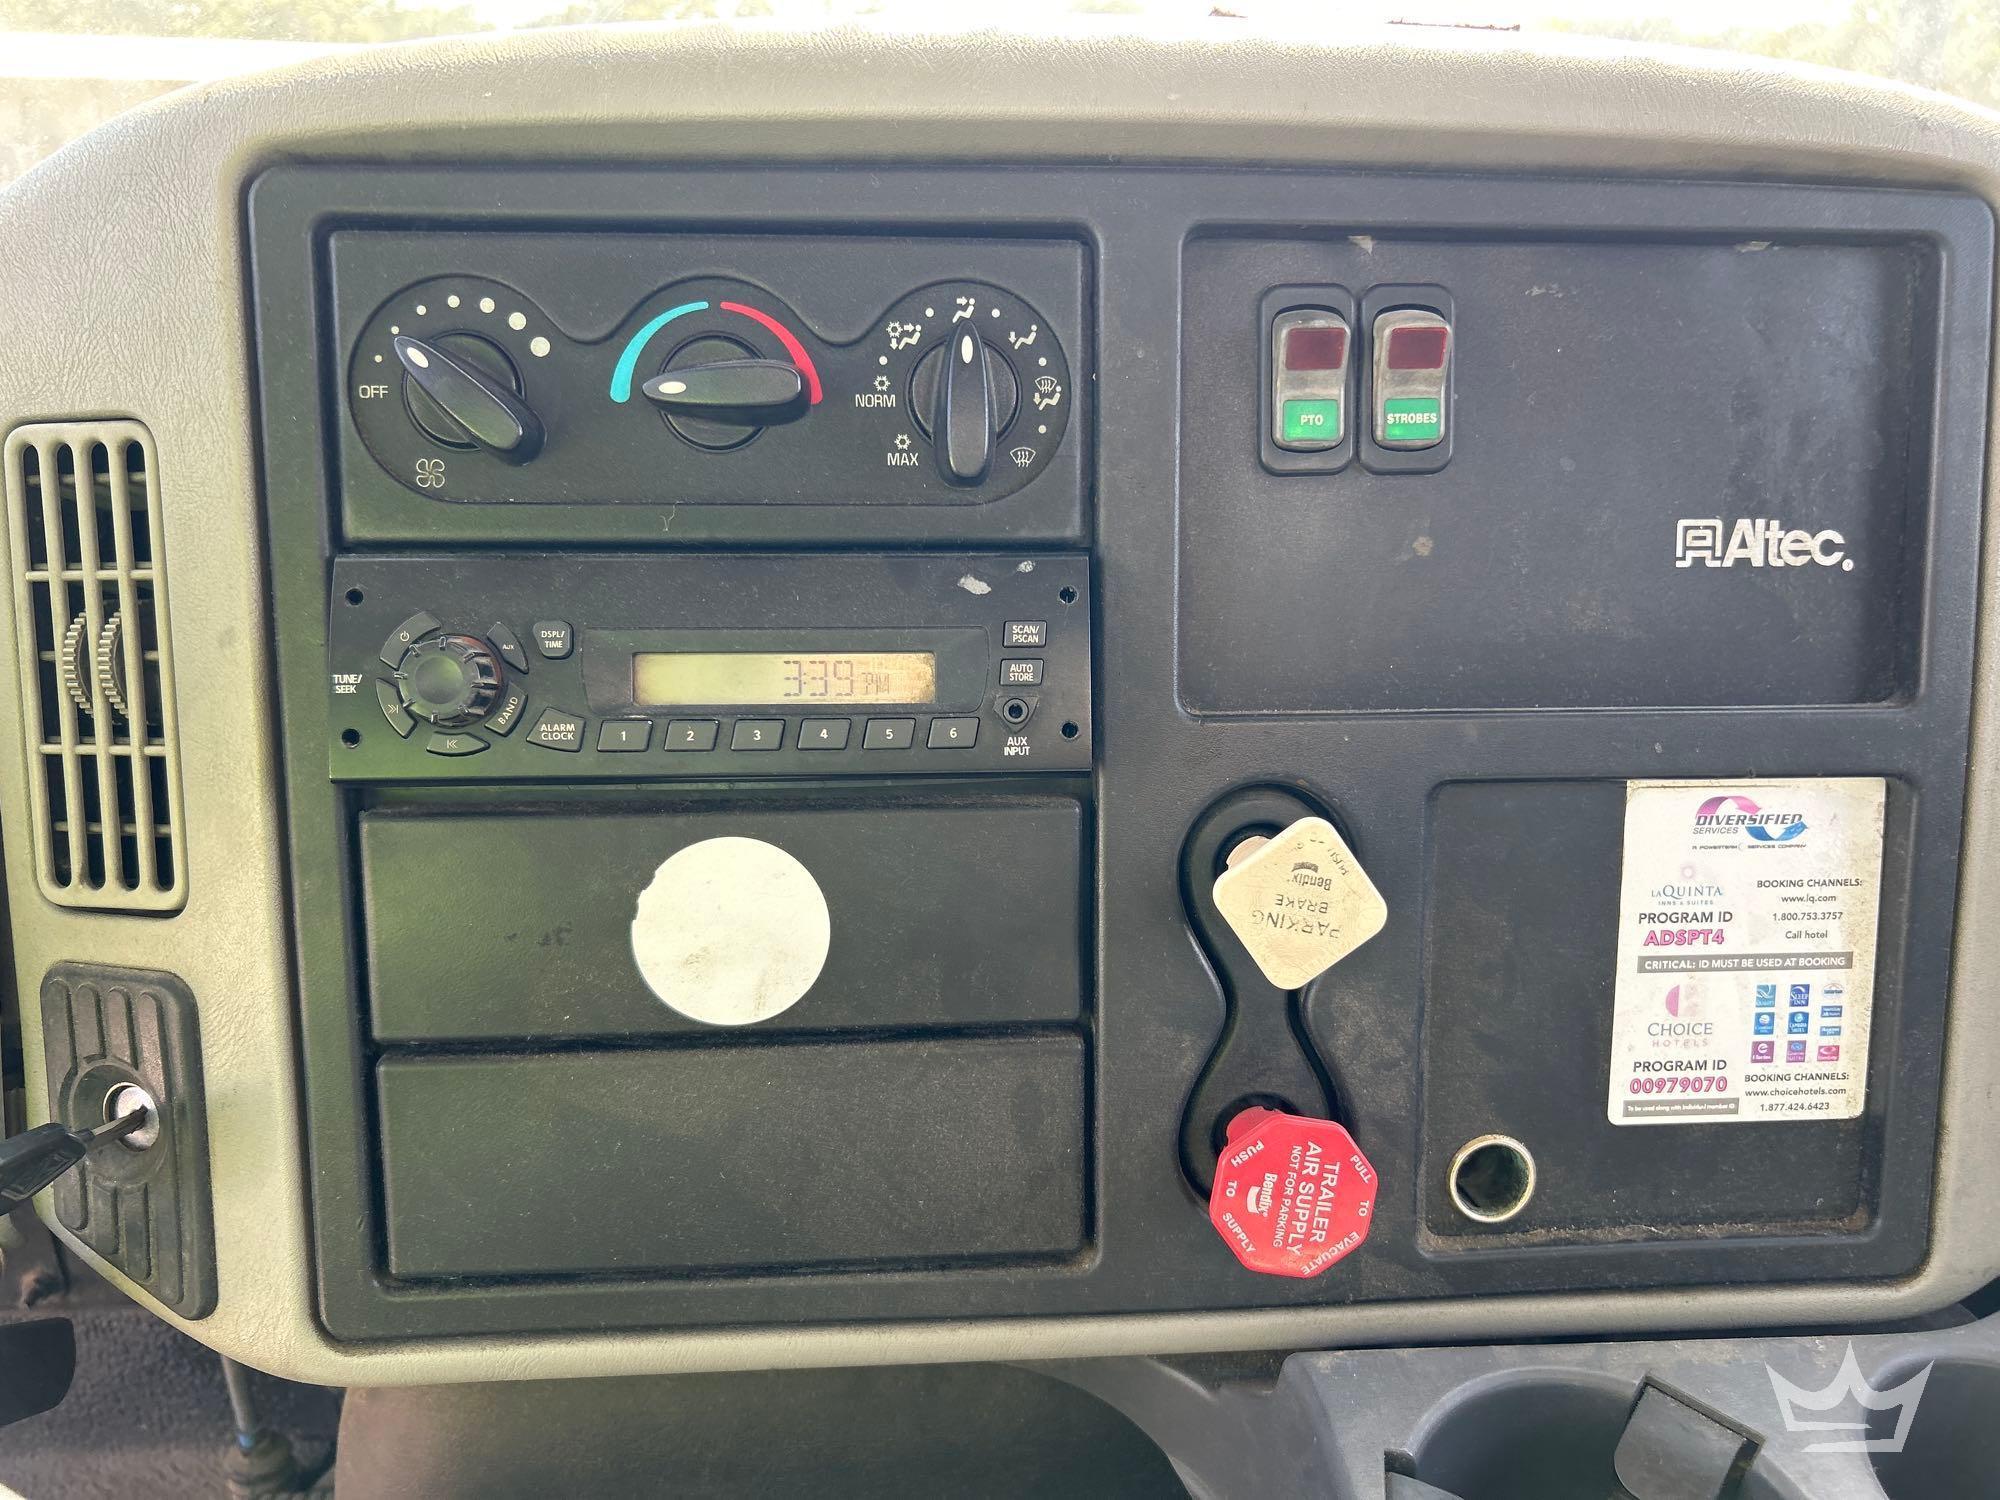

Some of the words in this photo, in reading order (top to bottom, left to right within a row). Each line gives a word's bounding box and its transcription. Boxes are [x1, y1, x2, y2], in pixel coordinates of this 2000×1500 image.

[358, 385, 389, 399] OFF
[855, 394, 896, 408] NORM
[1300, 414, 1323, 426] PTO
[1386, 413, 1438, 424] STROBES
[887, 452, 919, 466] MAX
[541, 630, 565, 640] DSPL/
[1012, 625, 1040, 635] SCAN/
[1012, 633, 1039, 643] PSCAN
[544, 640, 563, 649] TIME
[1009, 664, 1034, 674] AUTO
[333, 674, 362, 685] TUNE/
[783, 660, 853, 697] 3:39
[1009, 673, 1034, 682] STORE
[335, 684, 357, 694] SEEK
[497, 696, 519, 726] BAND
[540, 723, 575, 733] ALARM
[950, 728, 957, 739] 6
[541, 731, 574, 741] CLOCK
[620, 731, 626, 741] 1
[686, 731, 694, 741] 2
[753, 730, 761, 741] 3
[820, 729, 828, 739] 4
[885, 729, 893, 740] 5
[1006, 736, 1028, 746] AUX
[1004, 746, 1030, 756] INPUT
[1695, 813, 1803, 826] DIVERSIFIED
[1692, 827, 1739, 835] SERVICES
[1757, 879, 1804, 888] BOOKING
[1806, 878, 1862, 888] CHANNELS:
[1275, 894, 1329, 914] BRAKE
[1781, 894, 1837, 905] www.lq.com
[1638, 911, 1714, 924] PROGRAM
[1718, 911, 1733, 923] ID
[1772, 911, 1843, 922] 1.800.753.3757
[1252, 909, 1342, 940] PARKING
[1643, 929, 1725, 947] ADSPT4
[1785, 931, 1803, 939] Call
[1805, 930, 1828, 939] hotel
[1644, 960, 1696, 970] CRITICAL:
[1699, 960, 1709, 969] ID
[1711, 959, 1739, 968] MUST
[1741, 959, 1753, 968] BE
[1756, 958, 1782, 967] USED
[1783, 958, 1796, 967] AT
[1798, 957, 1845, 967] BOOKING
[1647, 1022, 1713, 1037] CHOICE
[1652, 1038, 1709, 1048] HOTELS
[1633, 1060, 1707, 1072] PROGRAM
[1712, 1060, 1727, 1071] ID
[1745, 1073, 1791, 1083] BOOKING
[1794, 1072, 1849, 1082] CHANNELS:
[1630, 1076, 1728, 1094] 00979070
[1745, 1087, 1846, 1097] www.choicehotels.com
[1760, 1102, 1830, 1112] 1.877.424.6423
[1230, 1140, 1265, 1167] PUSH
[1289, 1145, 1303, 1171] NOT
[1302, 1141, 1322, 1176] AIR
[1350, 1154, 1373, 1184] PULL
[1225, 1180, 1239, 1197] TO
[1284, 1171, 1297, 1196] FOR
[1309, 1161, 1340, 1243] TRAILER
[1358, 1200, 1370, 1217] TO
[1273, 1198, 1291, 1248] PARKING
[1286, 1181, 1315, 1256] SUPPLY
[1222, 1212, 1257, 1253] SUPPLY
[1302, 1231, 1360, 1275] EVACUATE
